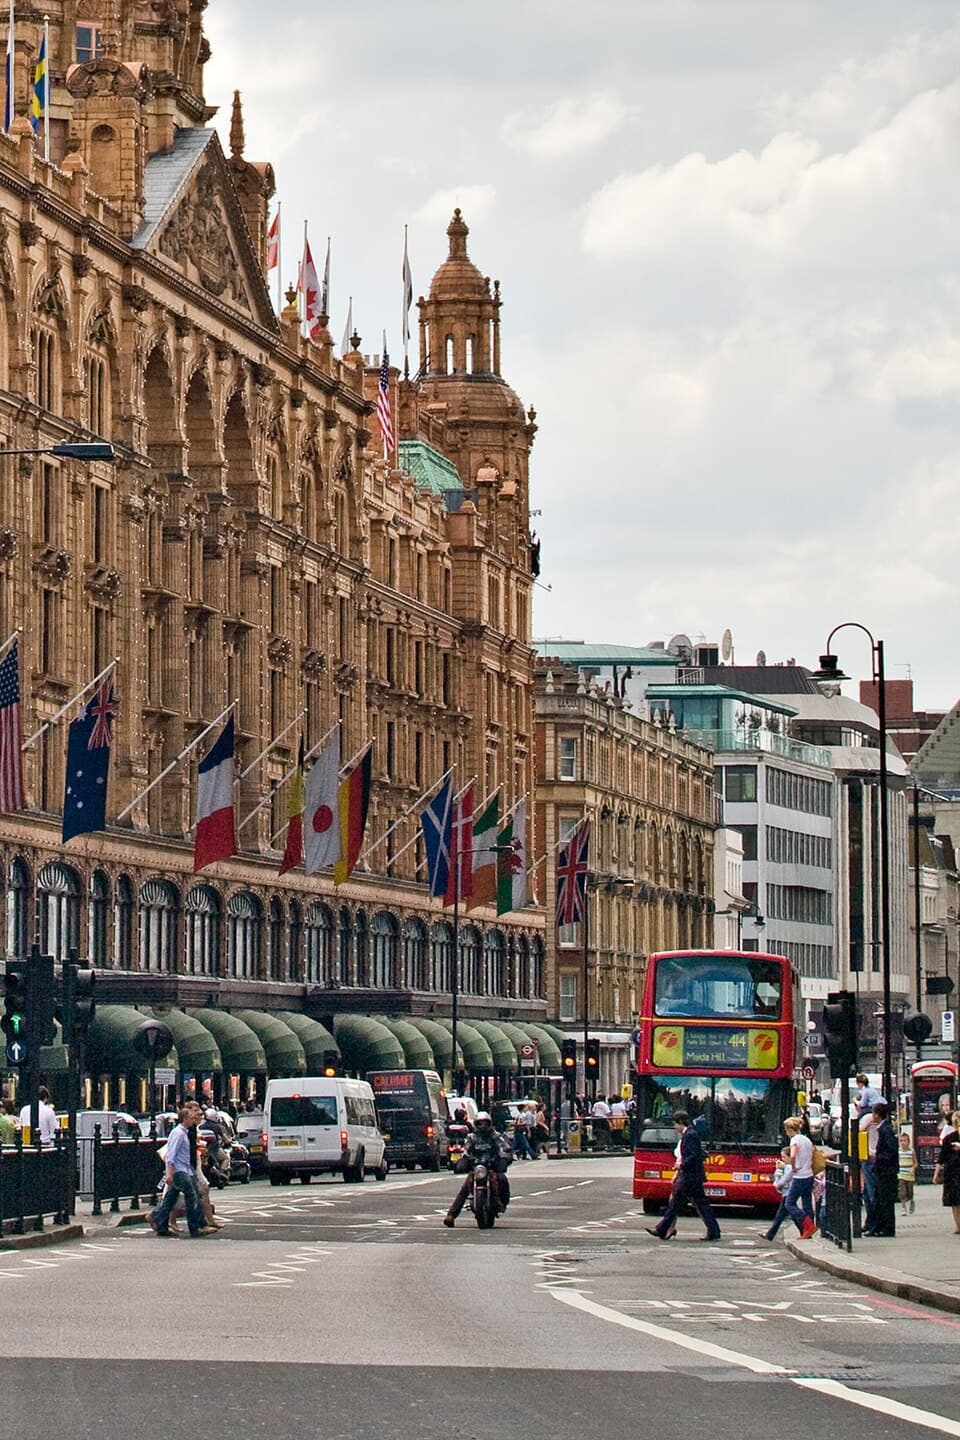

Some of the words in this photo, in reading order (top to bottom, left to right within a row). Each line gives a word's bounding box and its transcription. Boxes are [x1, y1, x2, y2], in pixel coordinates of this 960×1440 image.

[728, 1033, 747, 1048] 414
[373, 1074, 414, 1088] CALUMET
[603, 1299, 874, 1311] LANE
[671, 1312, 888, 1324] BUS
